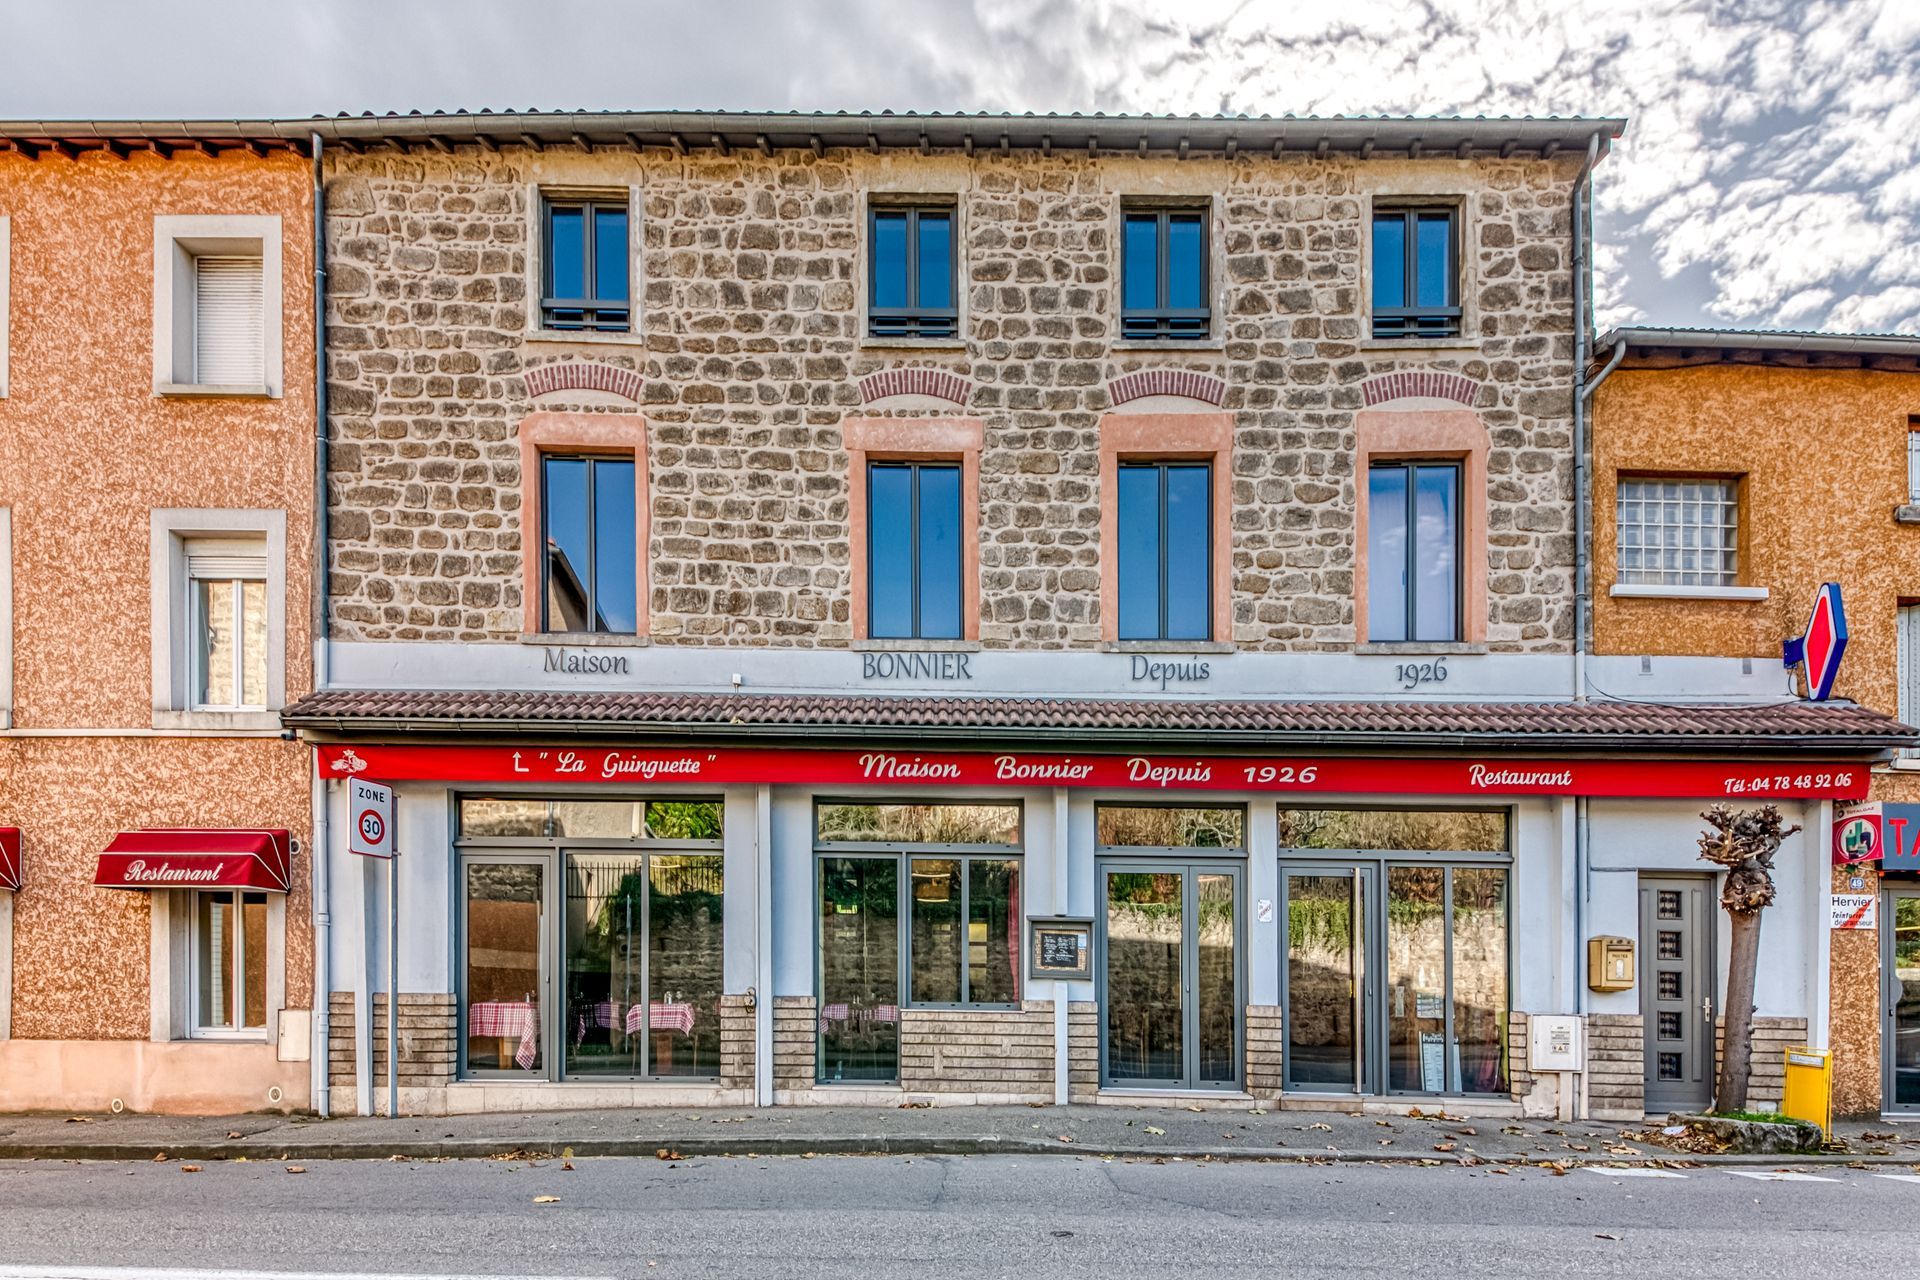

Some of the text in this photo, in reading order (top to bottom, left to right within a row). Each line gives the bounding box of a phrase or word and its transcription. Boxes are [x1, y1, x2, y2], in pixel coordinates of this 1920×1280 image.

[543, 646, 1448, 691] Maison BONNIER Depuis 1926
[859, 753, 1319, 788] Maison Bonnier Depuis 1926
[1468, 763, 1573, 788] Restaurant
[1774, 776, 1790, 790] 78
[1793, 774, 1812, 789] 48
[1814, 773, 1831, 789] 92
[1834, 772, 1852, 788] 06
[358, 786, 386, 804] ZONE
[363, 818, 381, 837] 30
[123, 859, 224, 883] Restaurant
[1852, 879, 1862, 888] 49
[1831, 896, 1871, 907] Hervier
